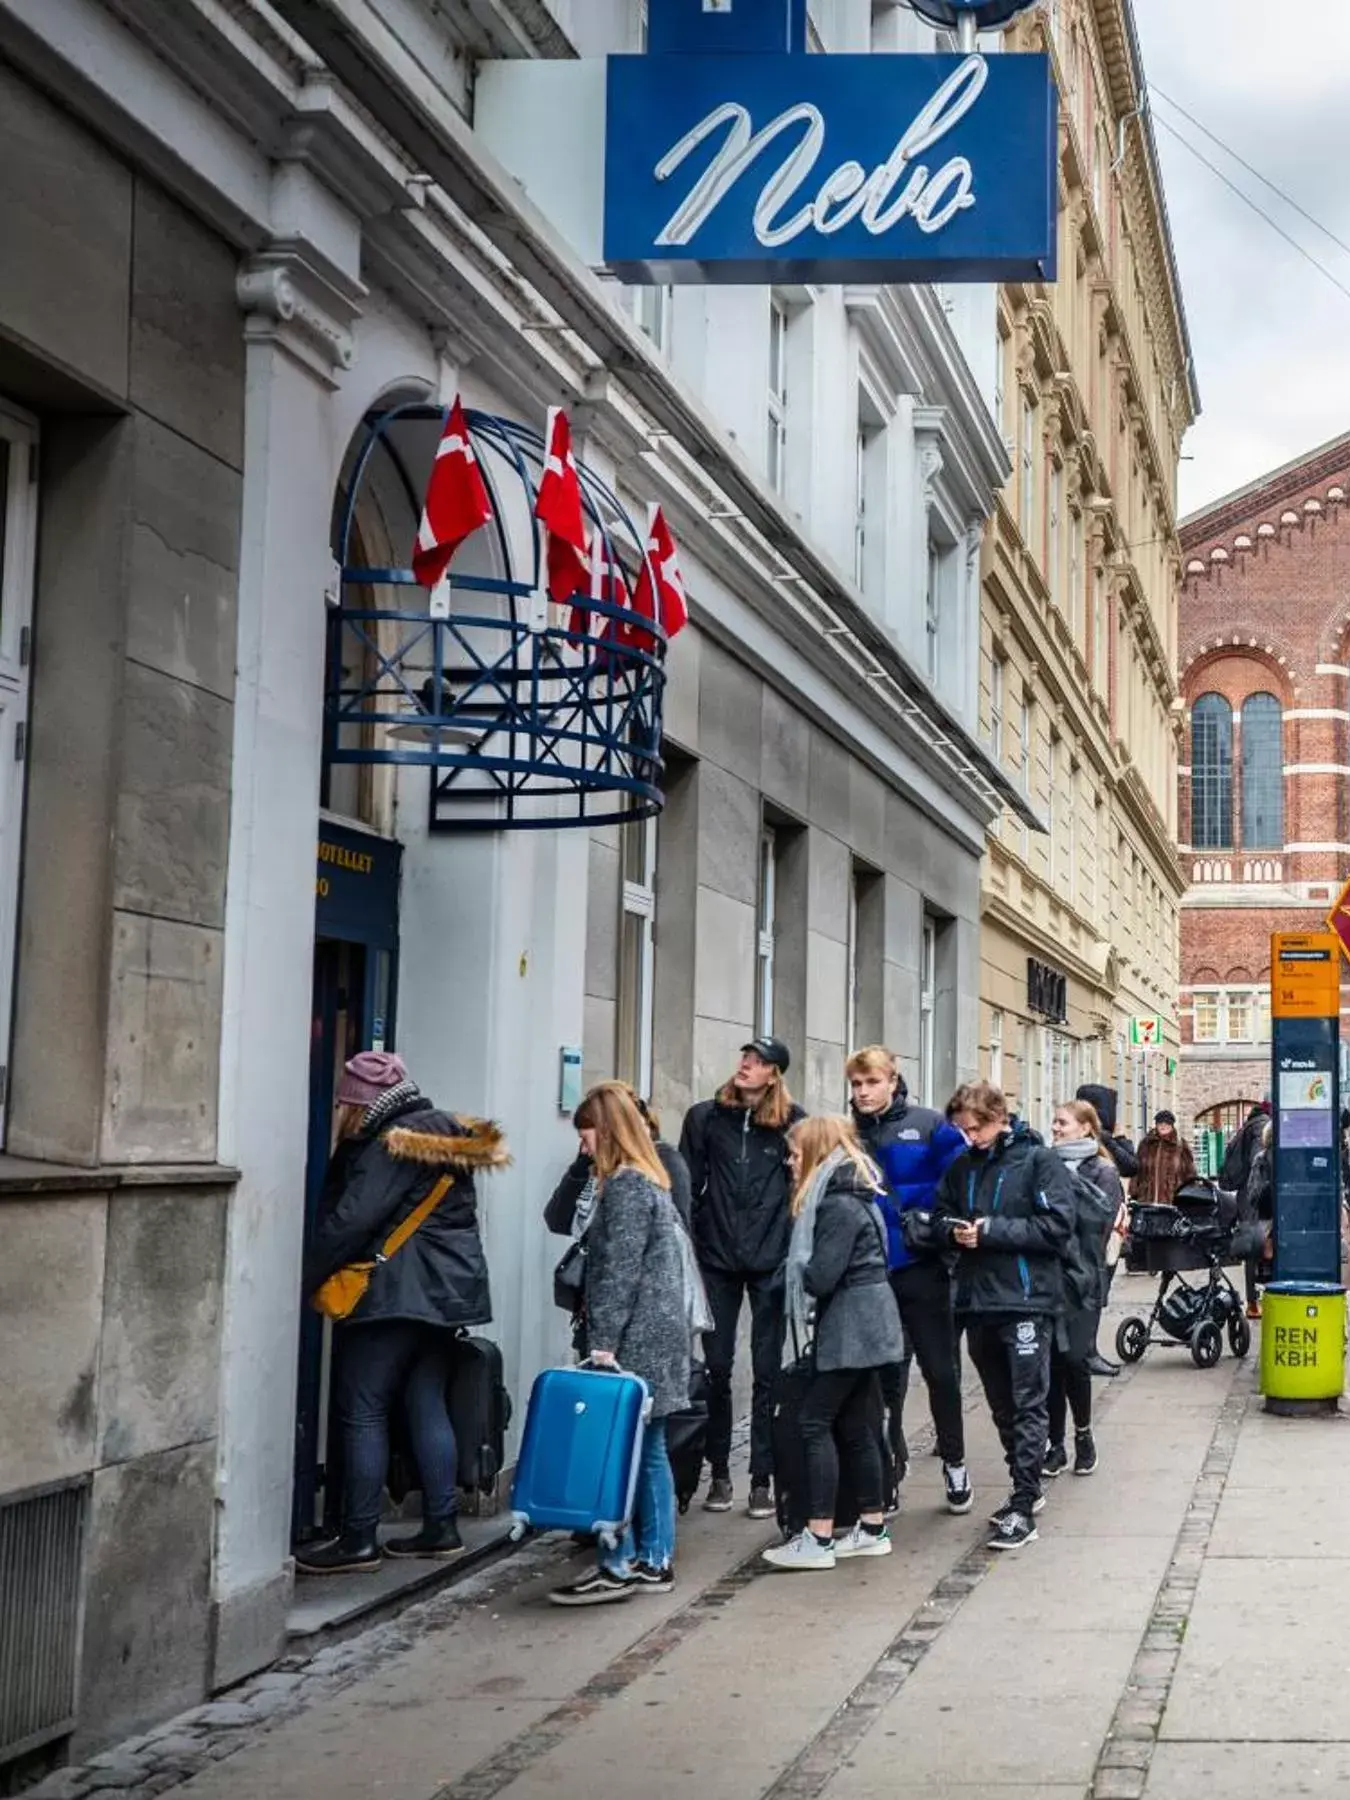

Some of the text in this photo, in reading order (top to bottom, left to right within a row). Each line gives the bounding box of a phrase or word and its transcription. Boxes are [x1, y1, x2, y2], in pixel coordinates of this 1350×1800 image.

[318, 842, 373, 874] OTELLET
[1275, 1326, 1317, 1343] REN
[1275, 1350, 1317, 1368] KBH
